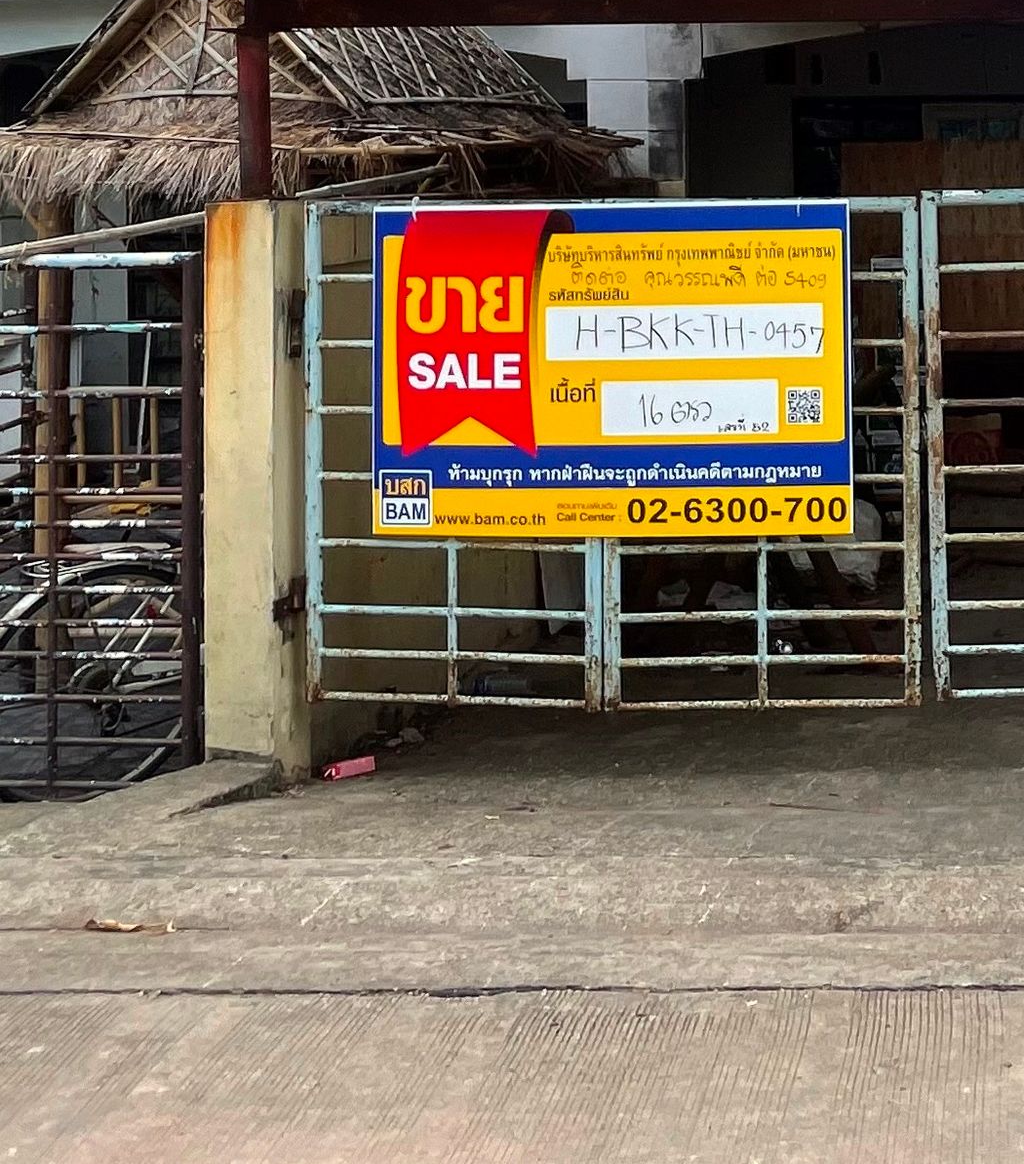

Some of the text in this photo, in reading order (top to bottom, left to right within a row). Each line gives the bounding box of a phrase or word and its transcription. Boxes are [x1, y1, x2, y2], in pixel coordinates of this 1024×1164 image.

[667, 241, 752, 266] กรุงเทพพาณิชย์
[755, 241, 785, 259] จำกัด
[788, 245, 836, 261] (มหาชน)
[405, 276, 524, 334] ขาย
[548, 288, 630, 302] รหัสทรัพย์สิน
[575, 313, 825, 354] H-BKK-TH-0457
[408, 352, 521, 390] SALE
[549, 377, 597, 404] เนื้อที่
[639, 393, 664, 428] 16
[385, 477, 427, 496] บสก
[448, 462, 822, 487] ห้ามบุกรุก หากฝ่าฝืนจะถูกดำเนินคดีตามกฎหมาย
[385, 502, 427, 521] BAM
[434, 513, 547, 526] www.bam.co.th
[556, 512, 616, 522] Call Center
[627, 496, 848, 524] 02-6300-700
